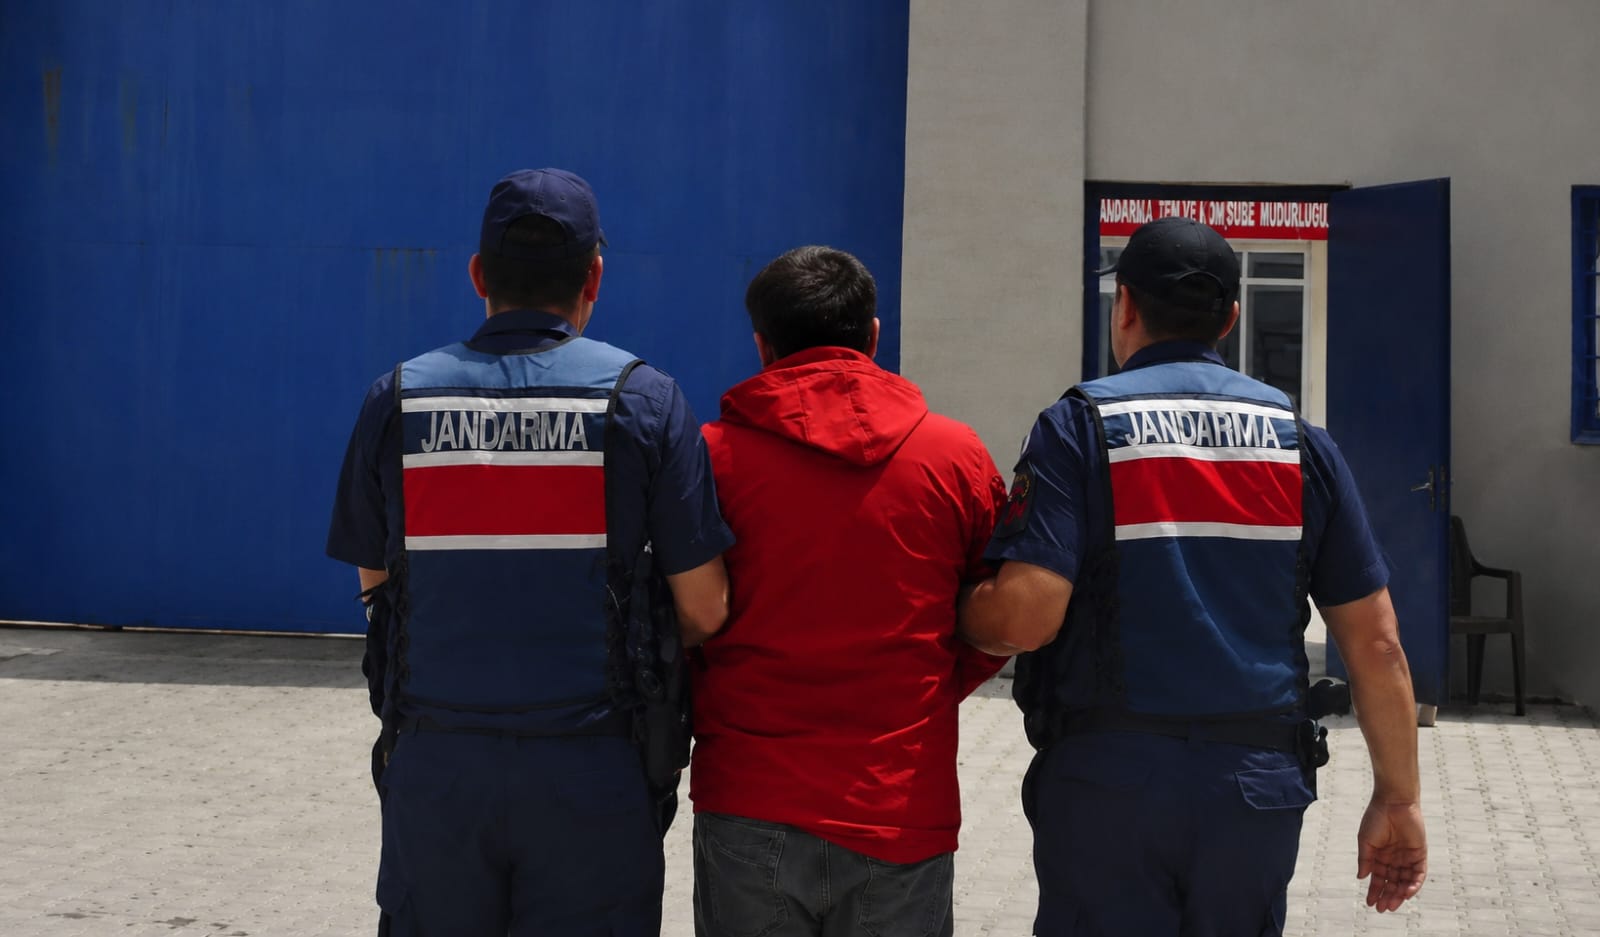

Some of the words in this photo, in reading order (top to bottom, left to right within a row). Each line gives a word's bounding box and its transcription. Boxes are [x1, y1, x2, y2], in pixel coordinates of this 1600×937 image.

[1099, 199, 1152, 223] ANDARMA
[1182, 200, 1197, 221] VE
[421, 411, 589, 452] JANDARMA
[1125, 410, 1281, 449] JANDARMA
